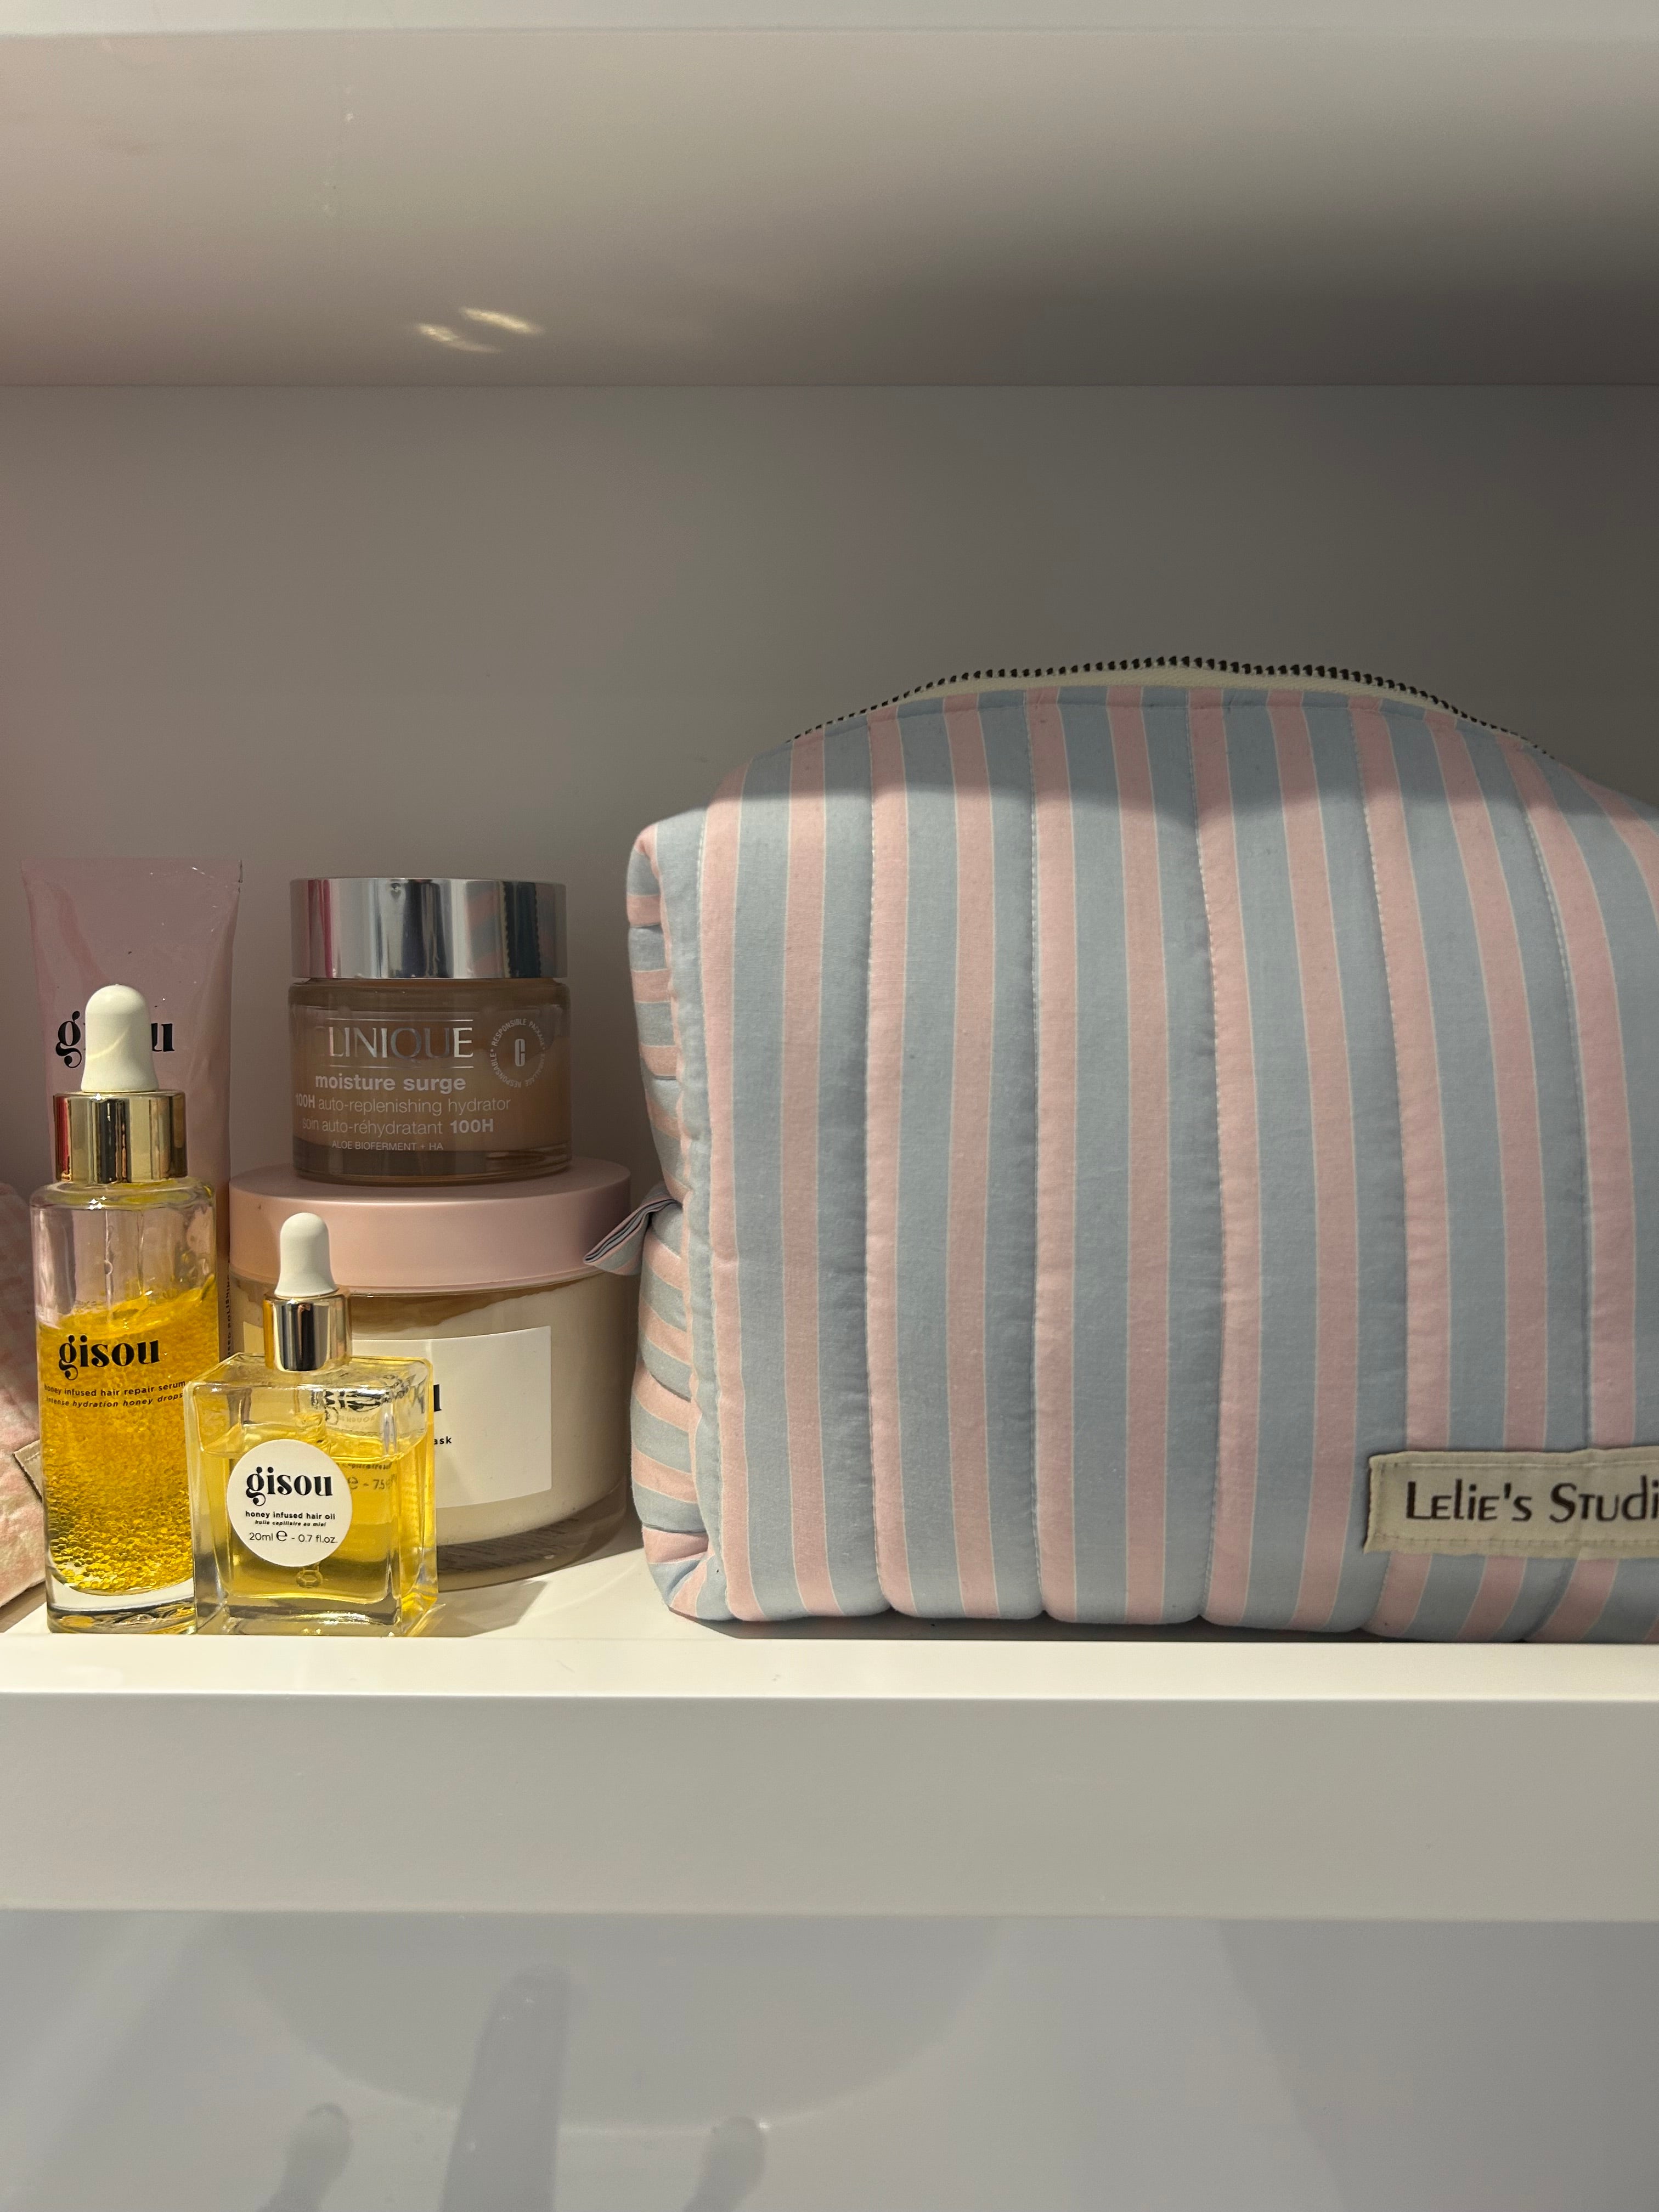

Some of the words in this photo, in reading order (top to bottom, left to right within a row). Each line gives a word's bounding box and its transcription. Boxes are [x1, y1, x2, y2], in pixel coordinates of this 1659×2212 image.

[492, 1018, 527, 1047] RESPONSIBLE
[328, 1026, 474, 1063] LINIQUE
[315, 1073, 396, 1091] moisture
[403, 1077, 466, 1095] surge
[295, 1093, 315, 1108] 100H
[319, 1097, 442, 1116] auto-replenishing
[448, 1097, 511, 1115] hydrator
[302, 1117, 319, 1130] soin
[322, 1119, 443, 1138] auto-réhydratant
[450, 1119, 494, 1134] 100H
[332, 1141, 353, 1150] ALOE
[355, 1141, 417, 1151] BIOFERMENT
[429, 1143, 444, 1151] HA
[58, 1334, 160, 1380] gisou
[44, 1383, 62, 1395] honey
[64, 1387, 97, 1397] infused
[124, 1386, 155, 1396] repair
[159, 1381, 185, 1391] serum
[46, 1397, 70, 1407] intense
[72, 1400, 119, 1408] hydration
[123, 1398, 153, 1406] honey
[157, 1392, 183, 1403] drops
[434, 1436, 452, 1444] ask
[246, 1466, 333, 1506] gisou
[1549, 1475, 1659, 1523] Studi
[245, 1510, 270, 1519] honey
[273, 1511, 303, 1520] infused
[249, 1532, 274, 1542] 20ml
